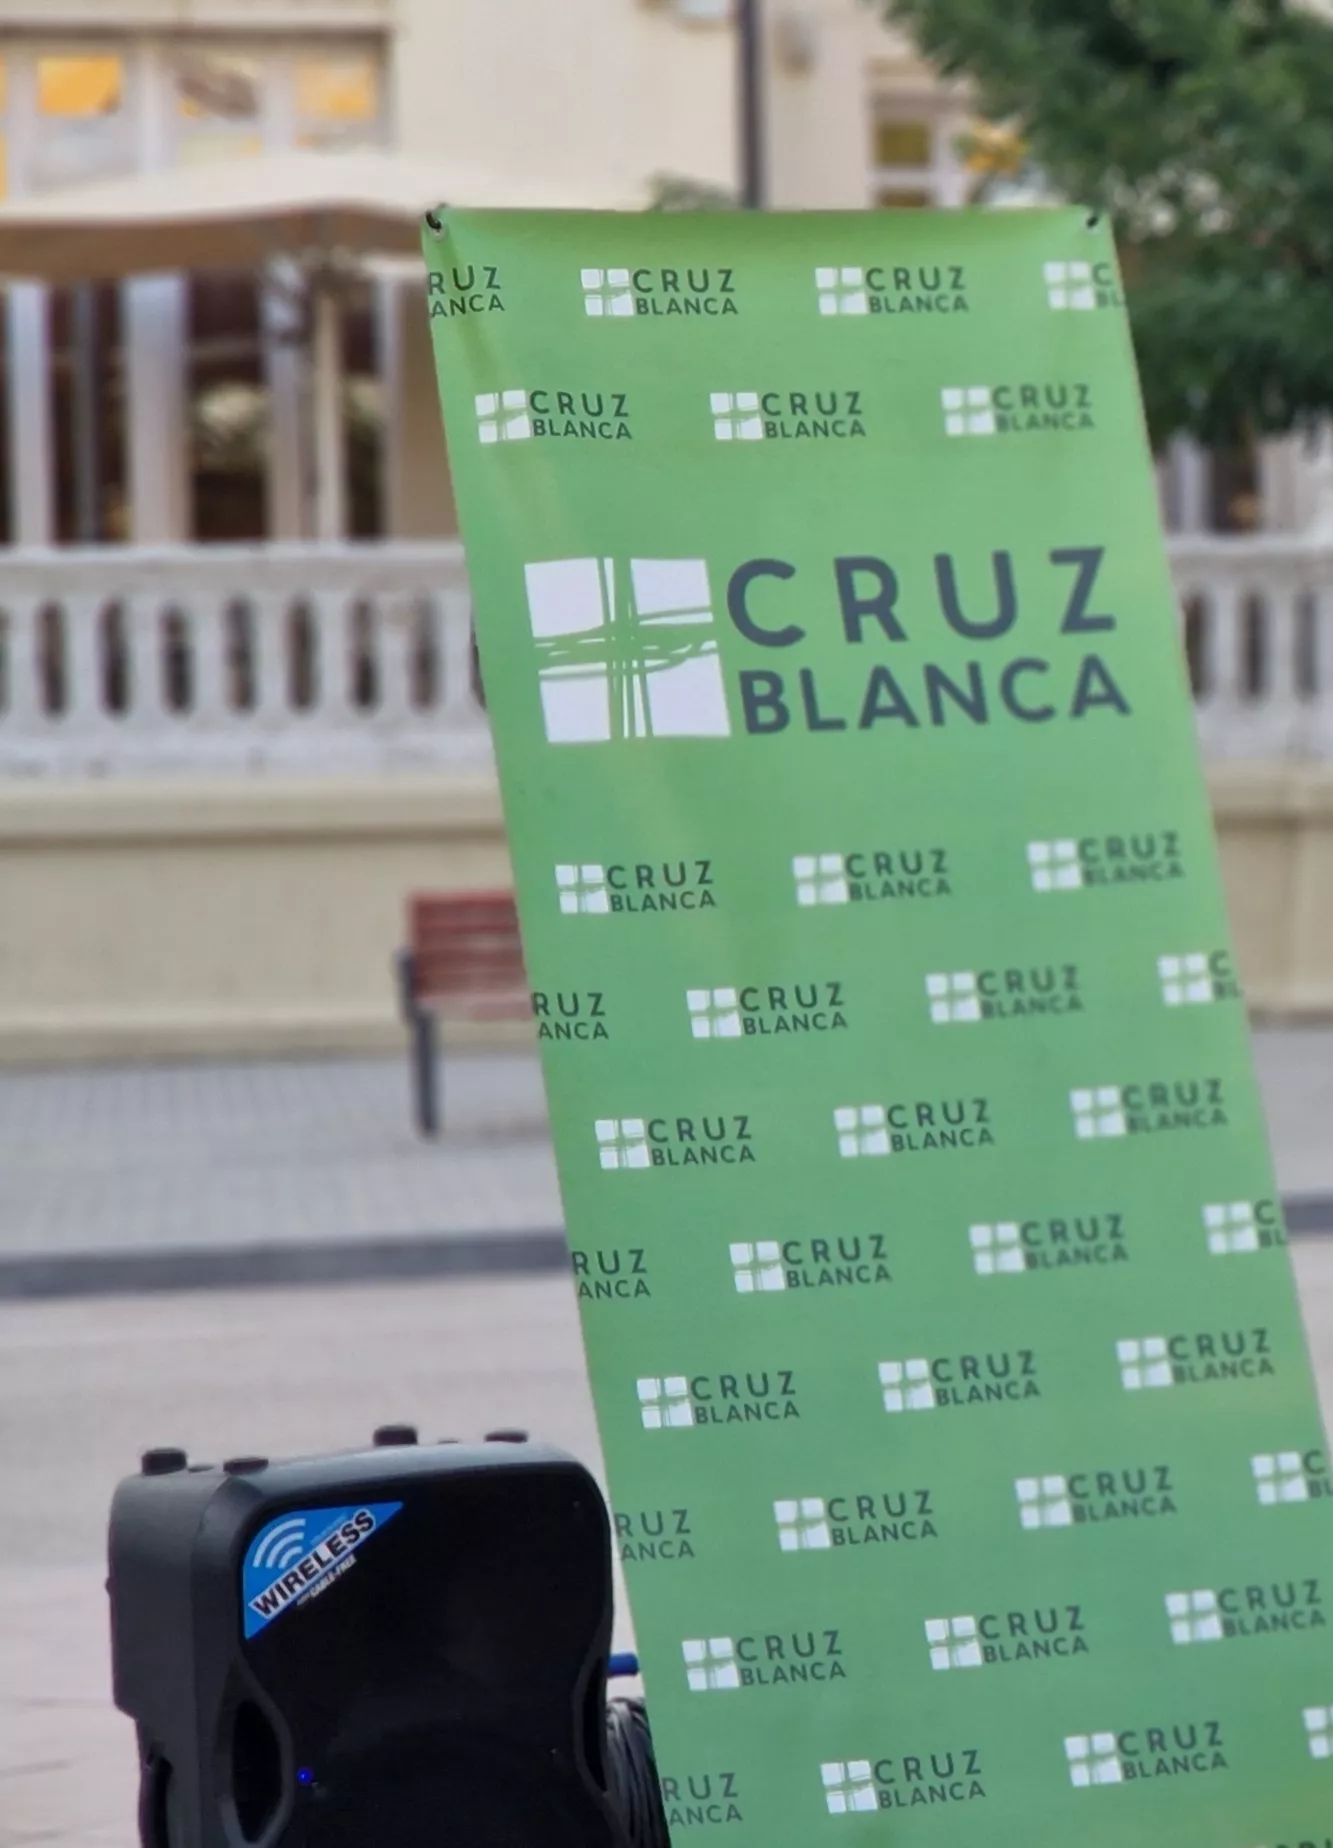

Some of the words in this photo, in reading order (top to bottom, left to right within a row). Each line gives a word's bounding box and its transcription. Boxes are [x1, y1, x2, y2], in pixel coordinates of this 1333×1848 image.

[428, 265, 502, 297] RUZ
[633, 269, 735, 294] CRUZ
[866, 267, 965, 293] CRUZ
[429, 293, 506, 319] ANCA
[636, 298, 738, 316] BLANCA
[869, 295, 968, 315] BLANCA
[529, 390, 629, 418] CRUZ
[761, 391, 862, 417] CRUZ
[992, 384, 1092, 412] CRUZ
[532, 419, 632, 440] BLANCA
[764, 419, 866, 439] BLANCA
[996, 411, 1095, 433] BLANCA
[727, 545, 1116, 648] CRUZ
[738, 653, 1132, 736] BLANCA
[1078, 832, 1180, 863] CRUZ
[607, 860, 713, 890] CRUZ
[845, 849, 949, 880] CRUZ
[1082, 860, 1184, 886] BLANCA
[610, 889, 716, 913] BLANCA
[849, 877, 951, 901] BLANCA
[977, 965, 1079, 996] CRUZ
[531, 992, 605, 1018] RUZ
[739, 982, 844, 1012] CRUZ
[981, 994, 1084, 1019] BLANCA
[537, 1020, 609, 1041] ANCA
[743, 1012, 847, 1036] BLANCA
[1122, 1079, 1224, 1111] CRUZ
[887, 1098, 990, 1130] CRUZ
[1126, 1108, 1228, 1134] BLANCA
[648, 1115, 751, 1144] CRUZ
[891, 1128, 994, 1153] BLANCA
[651, 1144, 756, 1167] BLANCA
[1021, 1214, 1124, 1247] CRUZ
[571, 1247, 647, 1277] RUZ
[782, 1234, 888, 1266] CRUZ
[1025, 1243, 1128, 1270] BLANCA
[577, 1278, 651, 1300] ANCA
[786, 1264, 892, 1289] BLANCA
[1168, 1328, 1271, 1361] CRUZ
[931, 1350, 1037, 1384] CRUZ
[1172, 1357, 1275, 1384] BLANCA
[690, 1371, 796, 1401] CRUZ
[935, 1380, 1041, 1407] BLANCA
[695, 1400, 800, 1425] BLANCA
[1068, 1466, 1172, 1500] CRUZ
[827, 1490, 934, 1523] CRUZ
[1072, 1496, 1177, 1524] BLANCA
[615, 1508, 691, 1538] RUZ
[831, 1520, 938, 1547] BLANCA
[251, 1509, 375, 1617] WIRELESS
[621, 1539, 695, 1562] ANCA
[1218, 1579, 1322, 1614] CRUZ
[978, 1605, 1084, 1640] CRUZ
[1222, 1610, 1326, 1638] BLANCA
[736, 1630, 842, 1662] CRUZ
[982, 1636, 1089, 1664] BLANCA
[740, 1661, 846, 1687] BLANCA
[1117, 1721, 1224, 1756] CRUZ
[874, 1750, 982, 1785] CRUZ
[1121, 1752, 1228, 1781] BLANCA
[663, 1772, 739, 1801] RUZ
[878, 1780, 986, 1810] BLANCA
[669, 1803, 743, 1826] ANCA
